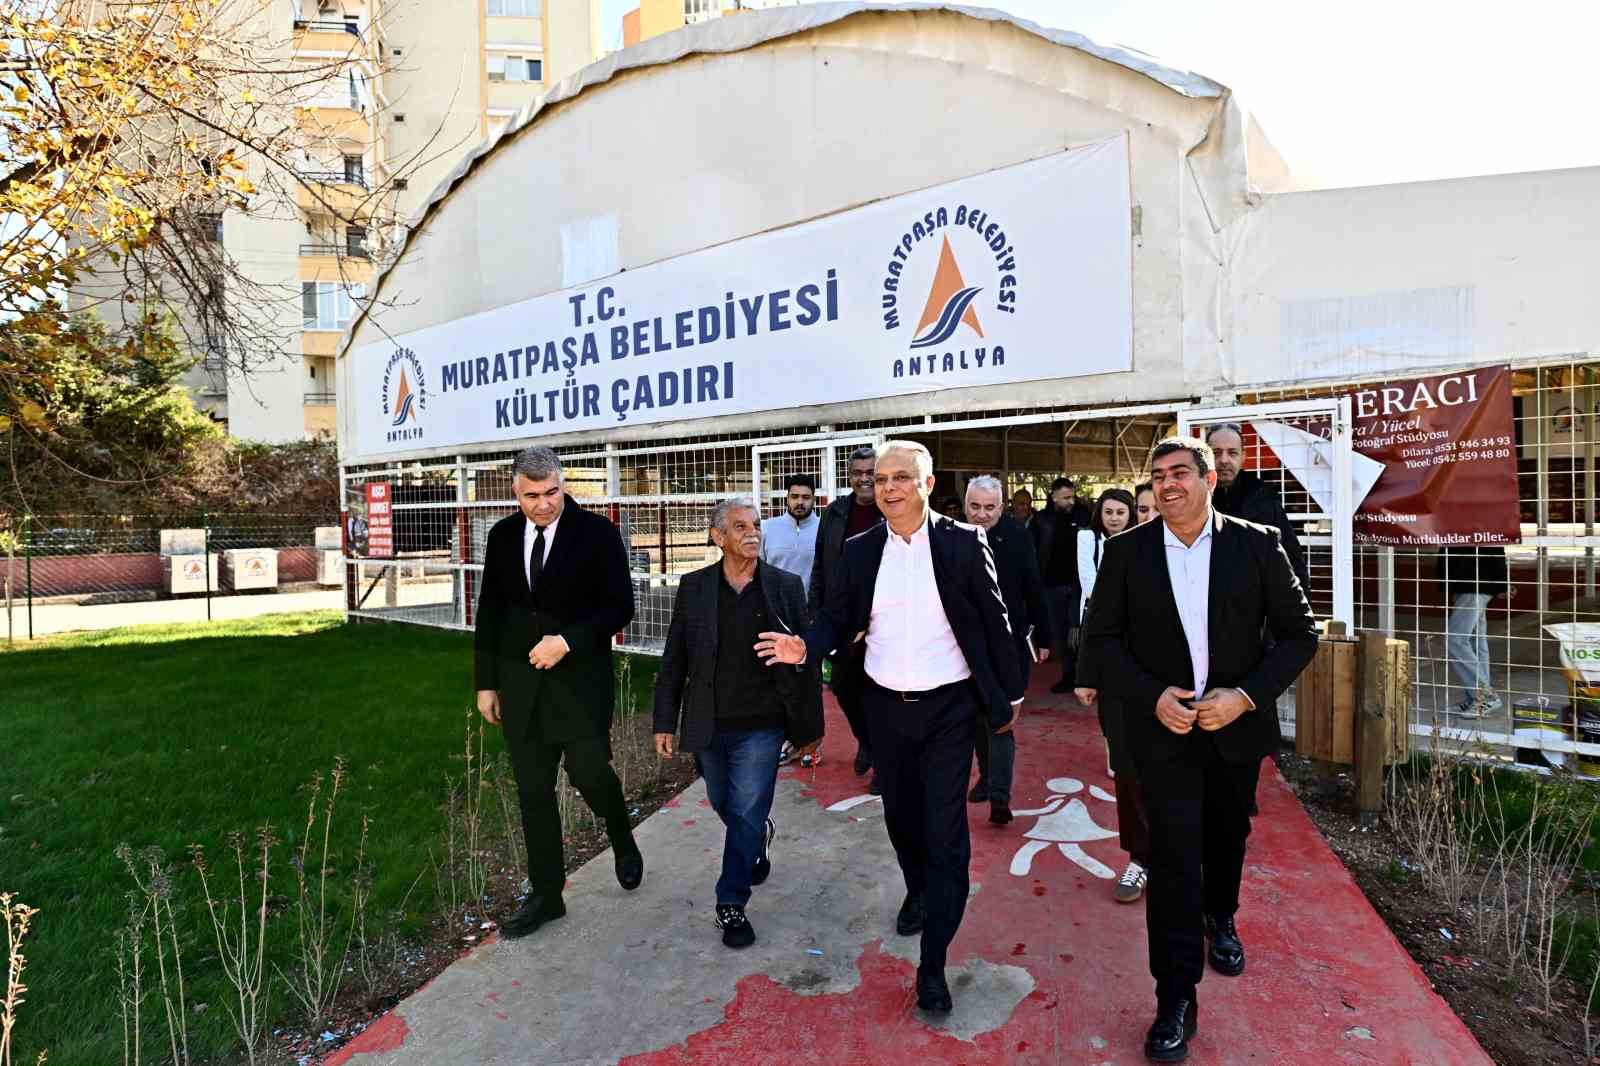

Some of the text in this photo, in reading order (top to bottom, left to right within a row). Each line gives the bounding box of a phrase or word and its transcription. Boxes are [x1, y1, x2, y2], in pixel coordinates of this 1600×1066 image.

[882, 204, 1017, 330] MURATPAŞA BELEDİYESİ
[569, 286, 626, 327] T.C.
[441, 268, 839, 393] MURATPAŞA BELEDİYESİ
[893, 345, 1005, 378] ANTALYA
[496, 361, 734, 429] KÜLTÜR ÇADIRI
[1344, 374, 1479, 418] ERACI
[386, 427, 423, 442] ANTALYA
[1381, 415, 1421, 433] Yücel
[1433, 453, 1457, 465] 0542
[1458, 451, 1478, 461] 559
[1480, 450, 1494, 459] 48
[1495, 448, 1510, 458] 80
[1459, 439, 1480, 449] 946
[1481, 438, 1495, 447] 34
[1496, 436, 1511, 446] 93
[1402, 533, 1471, 545] Mutluluklar
